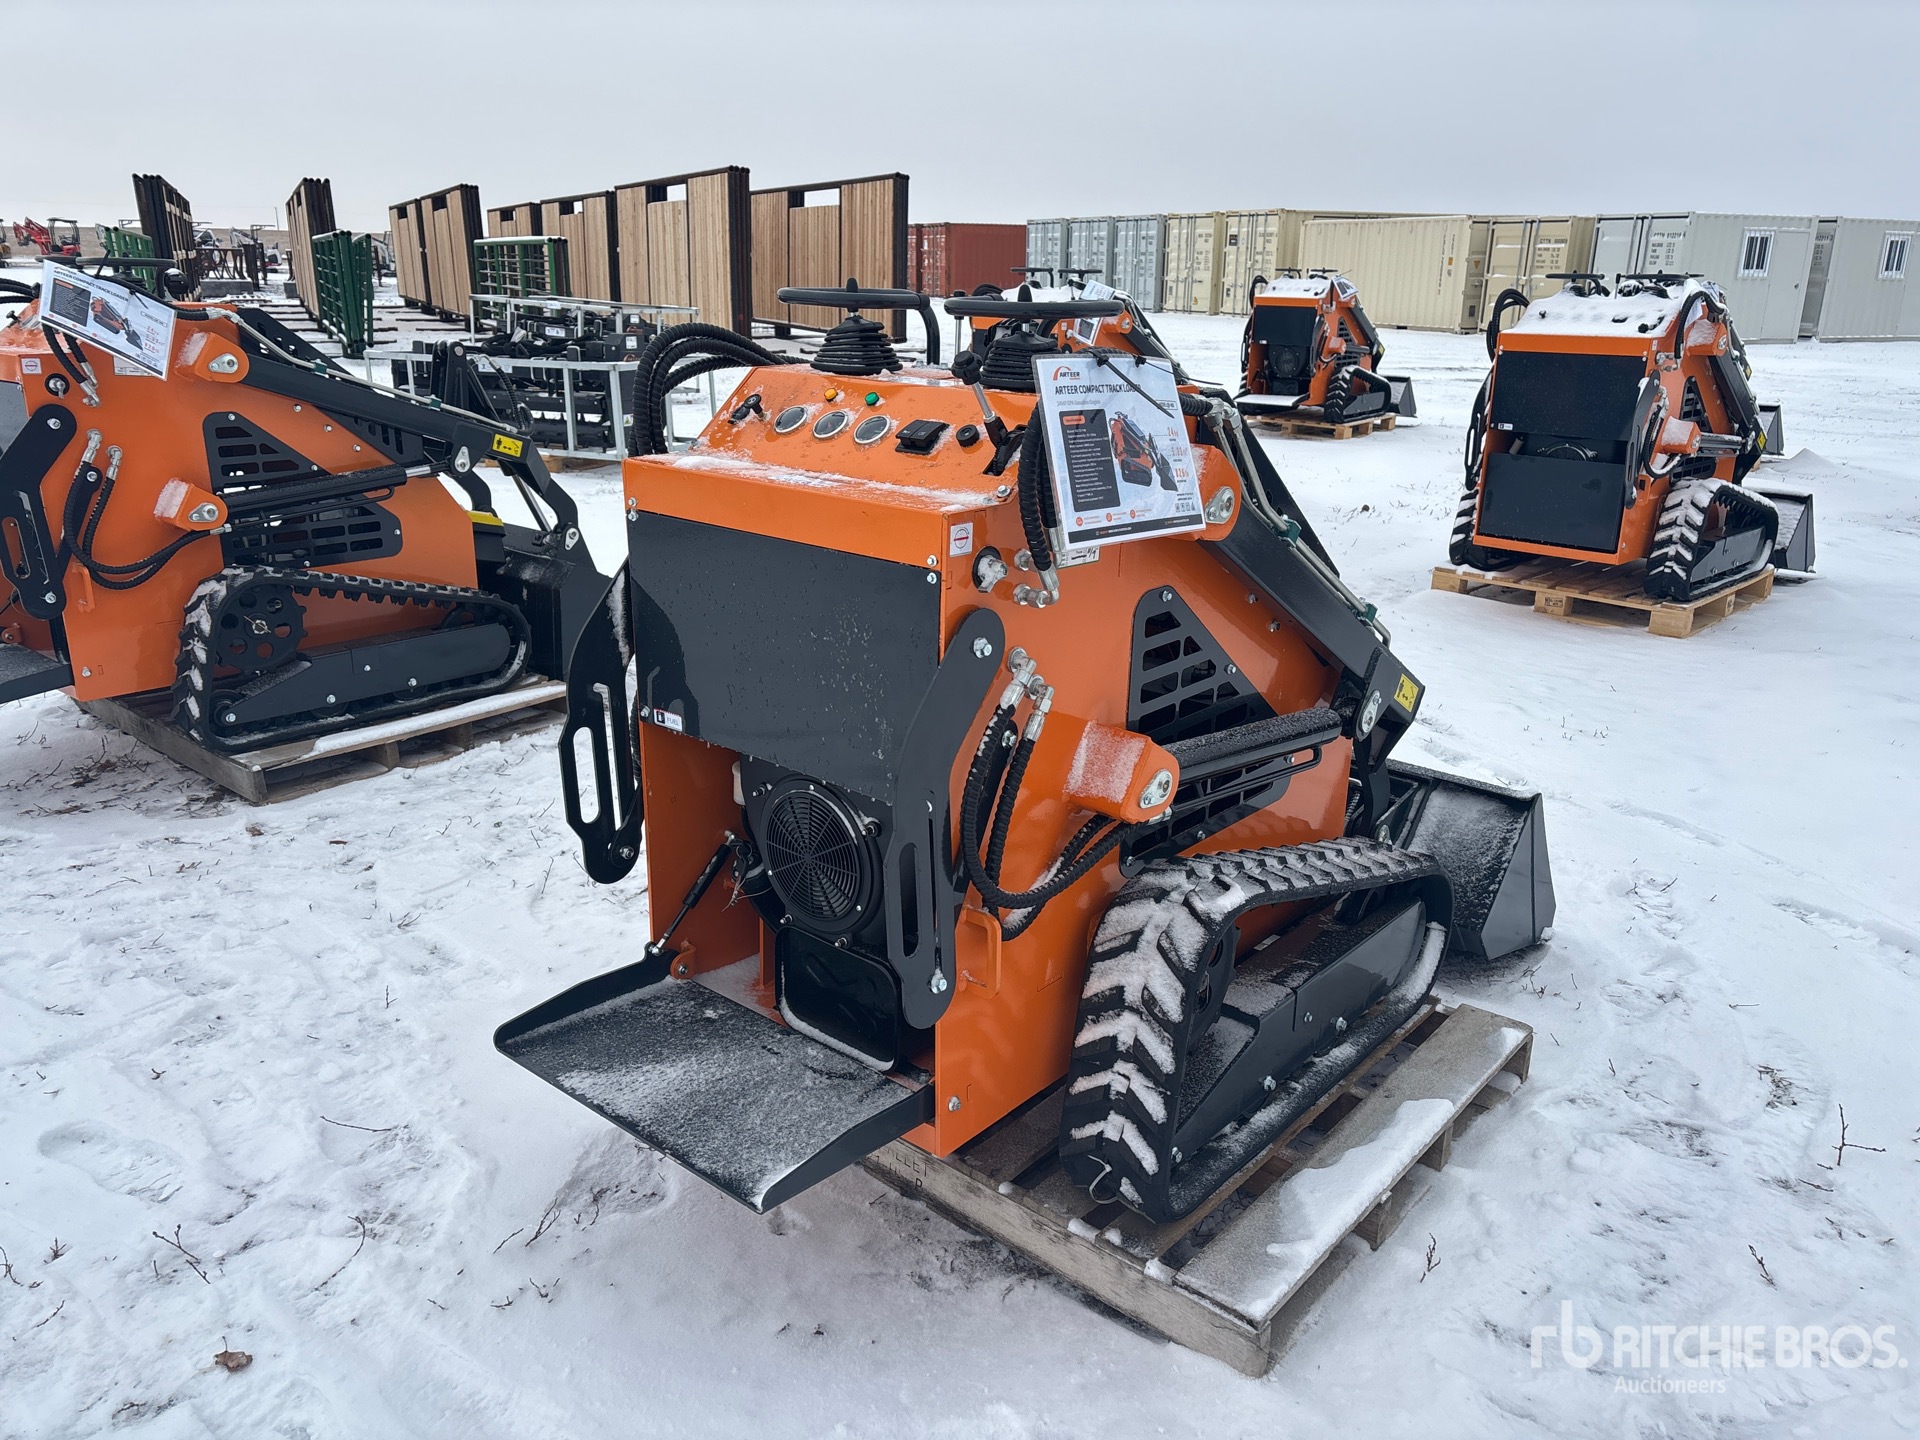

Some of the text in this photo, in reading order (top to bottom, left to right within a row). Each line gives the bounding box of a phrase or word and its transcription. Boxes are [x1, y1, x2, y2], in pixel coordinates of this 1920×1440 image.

[1055, 384, 1079, 396] ARTEER
[1078, 384, 1105, 395] COMPACT
[1105, 384, 1124, 393] TRACK
[667, 717, 680, 726] FUEL
